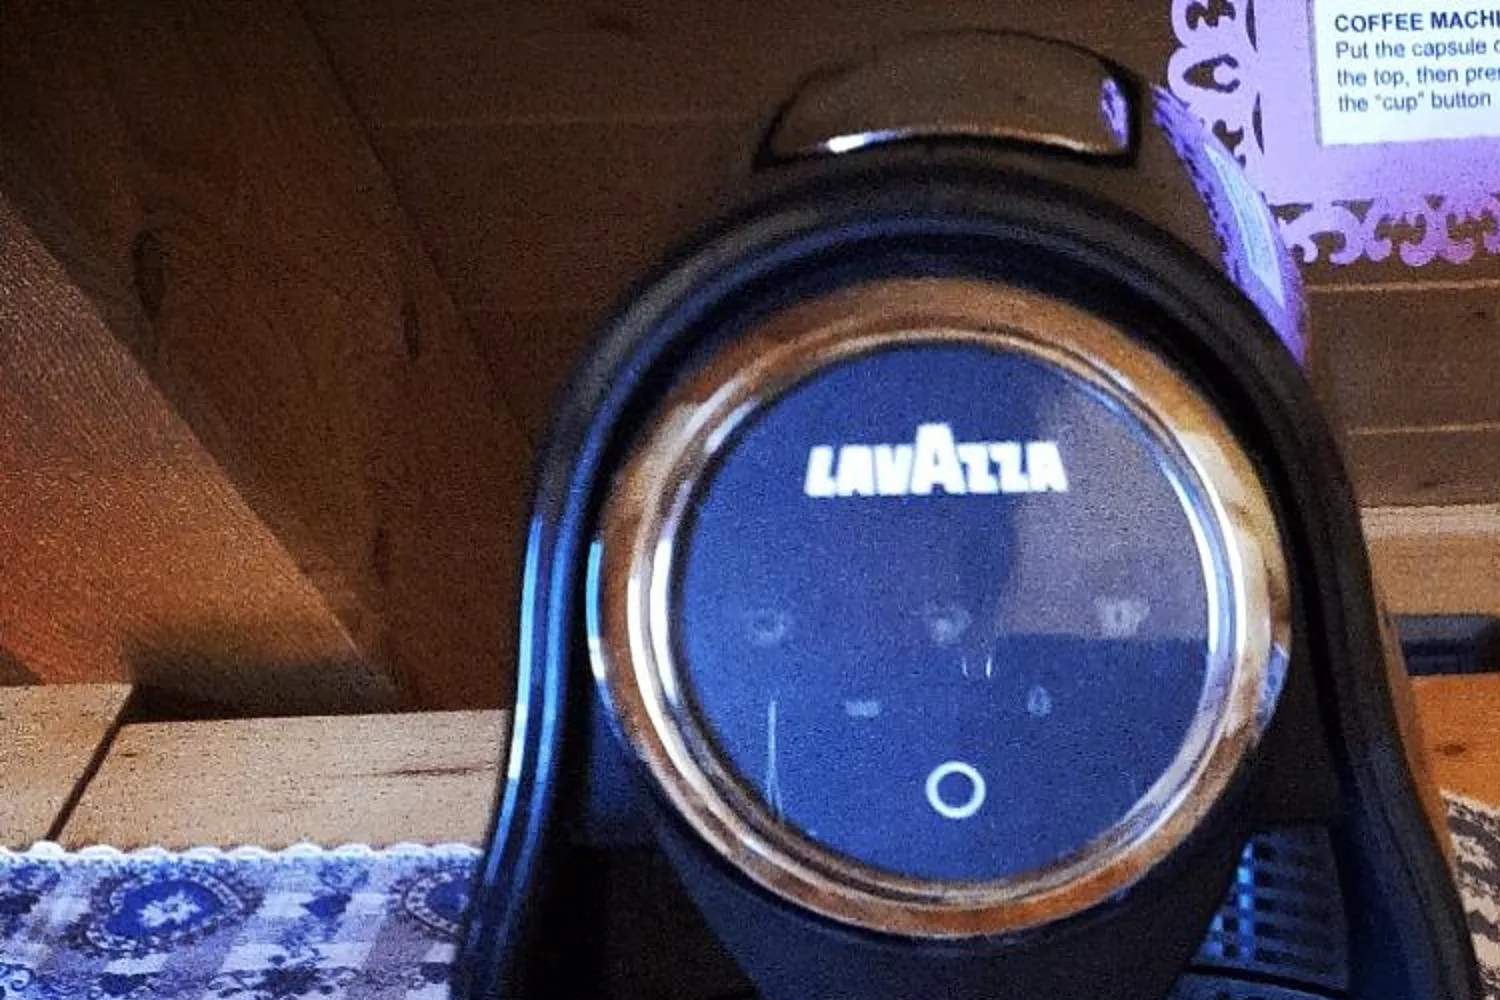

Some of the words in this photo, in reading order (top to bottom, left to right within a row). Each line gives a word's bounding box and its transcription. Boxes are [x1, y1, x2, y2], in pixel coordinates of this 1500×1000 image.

[1334, 13, 1424, 32] COFFEE
[1335, 41, 1368, 59] Put
[1375, 40, 1405, 58] the
[1411, 38, 1487, 60] capsule
[1337, 69, 1367, 87] the
[1374, 69, 1410, 88] top,
[1417, 66, 1458, 84] then
[1339, 94, 1368, 112] the
[1431, 91, 1491, 109] button
[803, 422, 1069, 498] LAVAZZA
